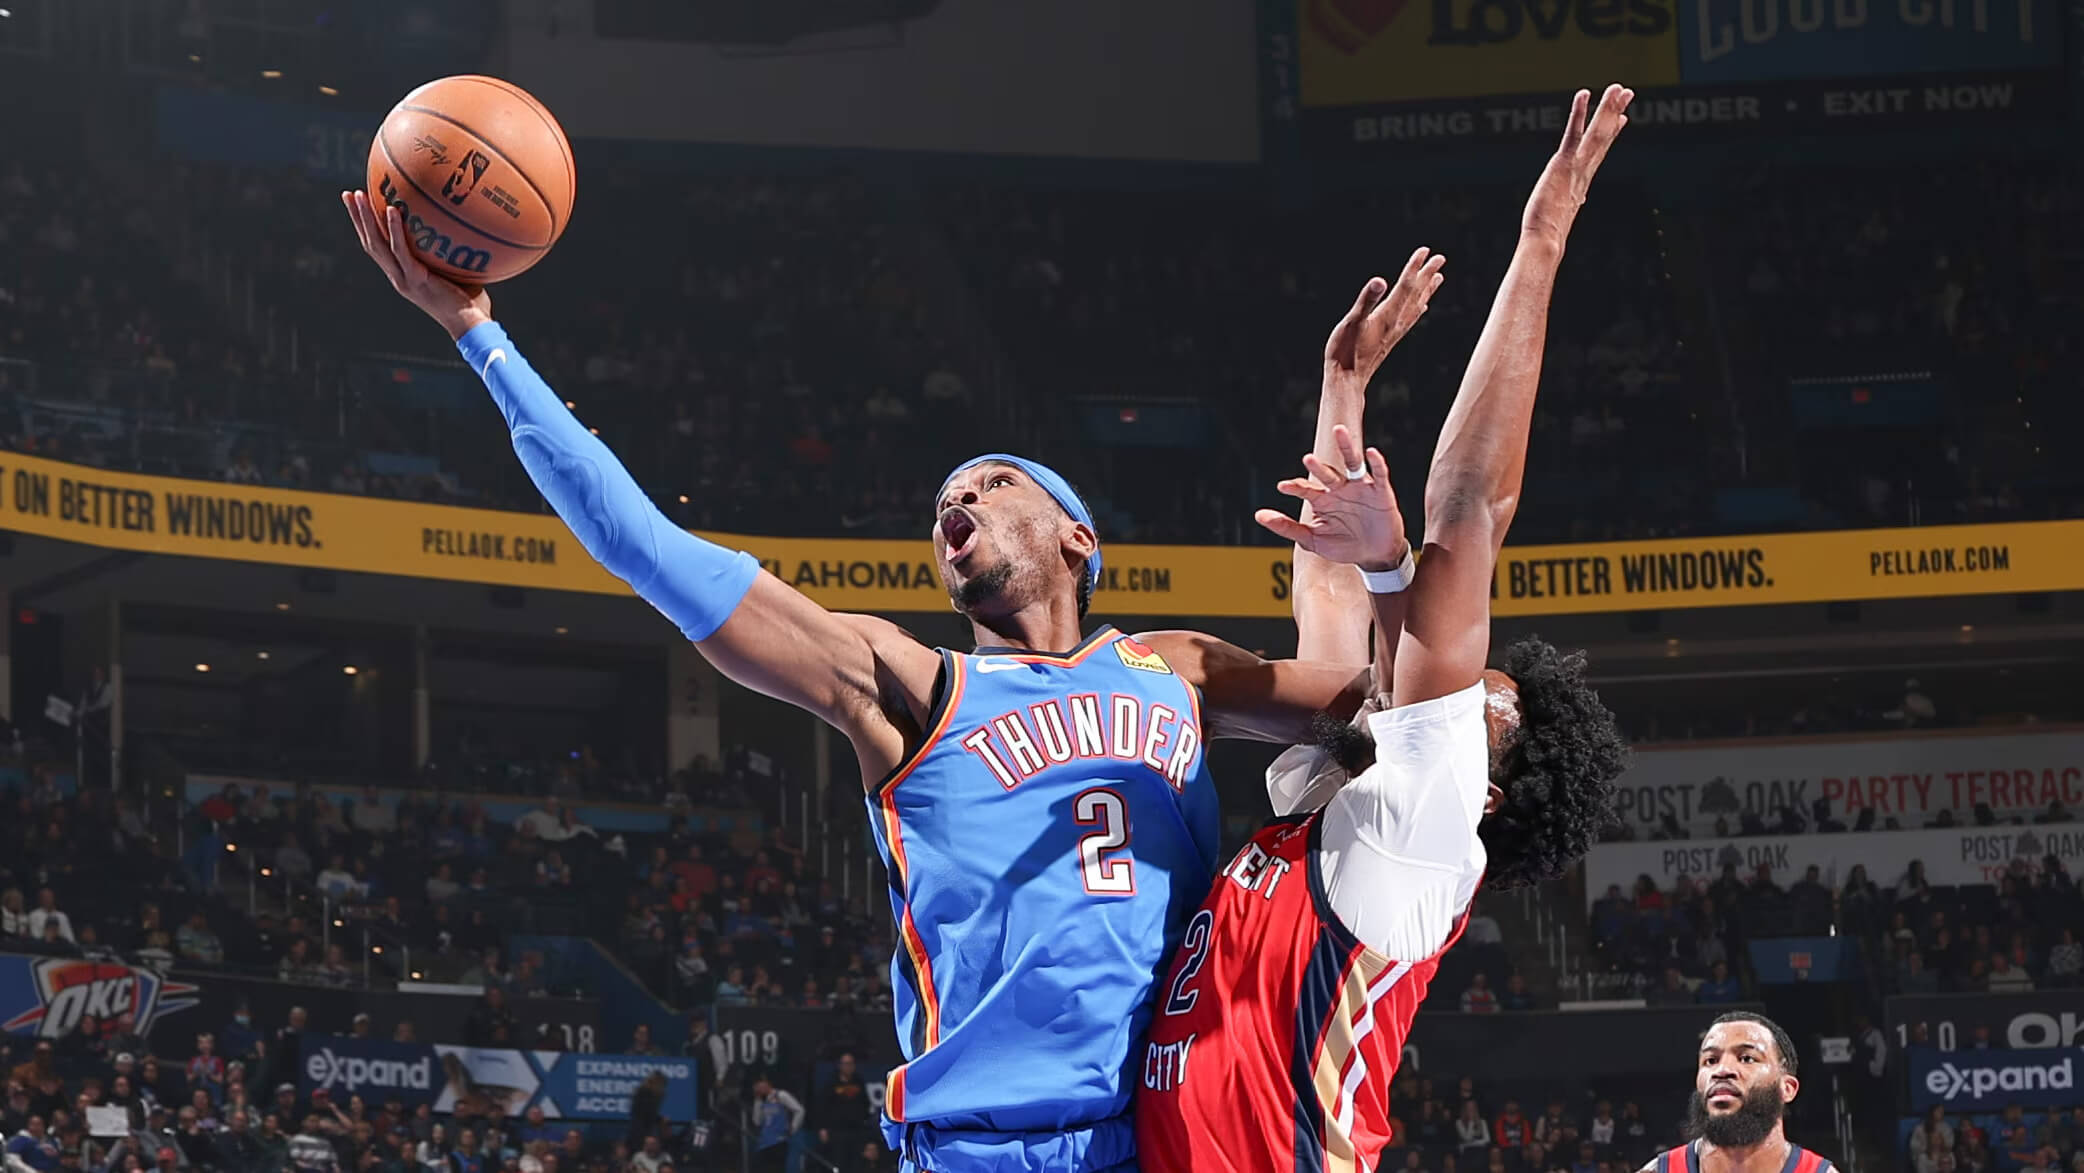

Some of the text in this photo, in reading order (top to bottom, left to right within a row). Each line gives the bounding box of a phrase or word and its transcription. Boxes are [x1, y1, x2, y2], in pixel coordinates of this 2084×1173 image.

[1353, 82, 2015, 142] BRING THE UNDER EXIT NOW
[14, 468, 50, 518] ON
[59, 477, 156, 534] BETTER
[165, 491, 324, 549] WINDOWS.
[422, 527, 557, 565] PELLAOK.COM
[1869, 545, 2010, 577] PELLAOK.COM
[762, 559, 938, 590] LAHOMA
[1509, 547, 1775, 600] BETTER WINDOWS.
[962, 693, 1202, 793] THUNDER
[1617, 784, 1696, 824] POST
[1822, 772, 1933, 815] PARTY
[1945, 766, 2084, 811] TERRAC
[1073, 786, 1138, 898] 2
[1662, 847, 1715, 876] POST
[1961, 834, 2014, 863] POST
[1164, 908, 1214, 1017] 2
[40, 976, 134, 1039] OKC
[306, 1047, 431, 1091] expand
[575, 1060, 690, 1079] EXPANDING
[722, 1029, 779, 1066] 109
[1144, 1032, 1197, 1092] CITY
[1925, 1057, 2074, 1101] expand
[575, 1096, 632, 1114] ACCE
